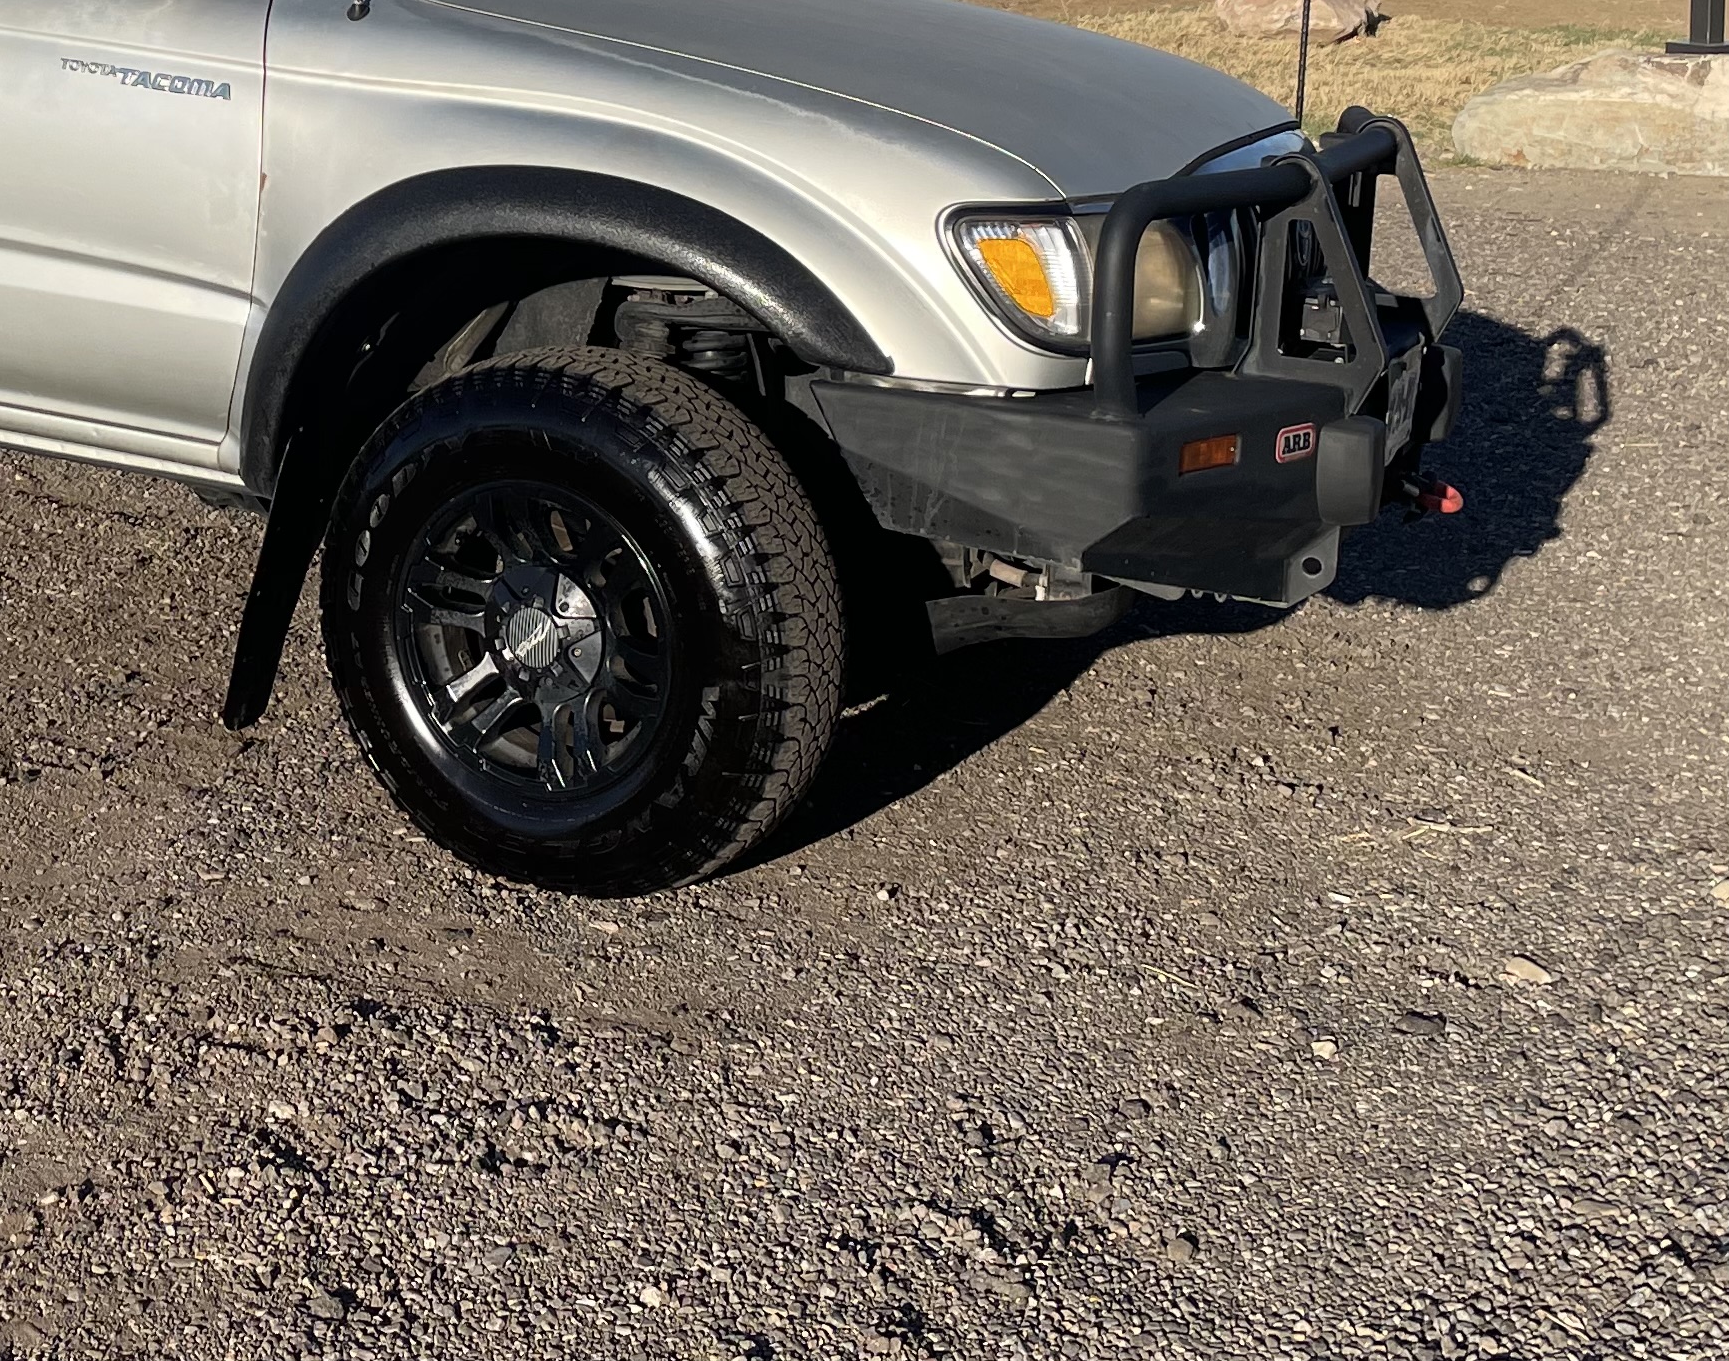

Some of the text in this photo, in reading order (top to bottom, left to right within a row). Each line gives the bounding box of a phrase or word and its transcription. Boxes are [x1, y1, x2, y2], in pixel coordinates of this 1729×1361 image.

[60, 57, 232, 101] TOYOTA TACOMA
[1281, 431, 1311, 455] ARB
